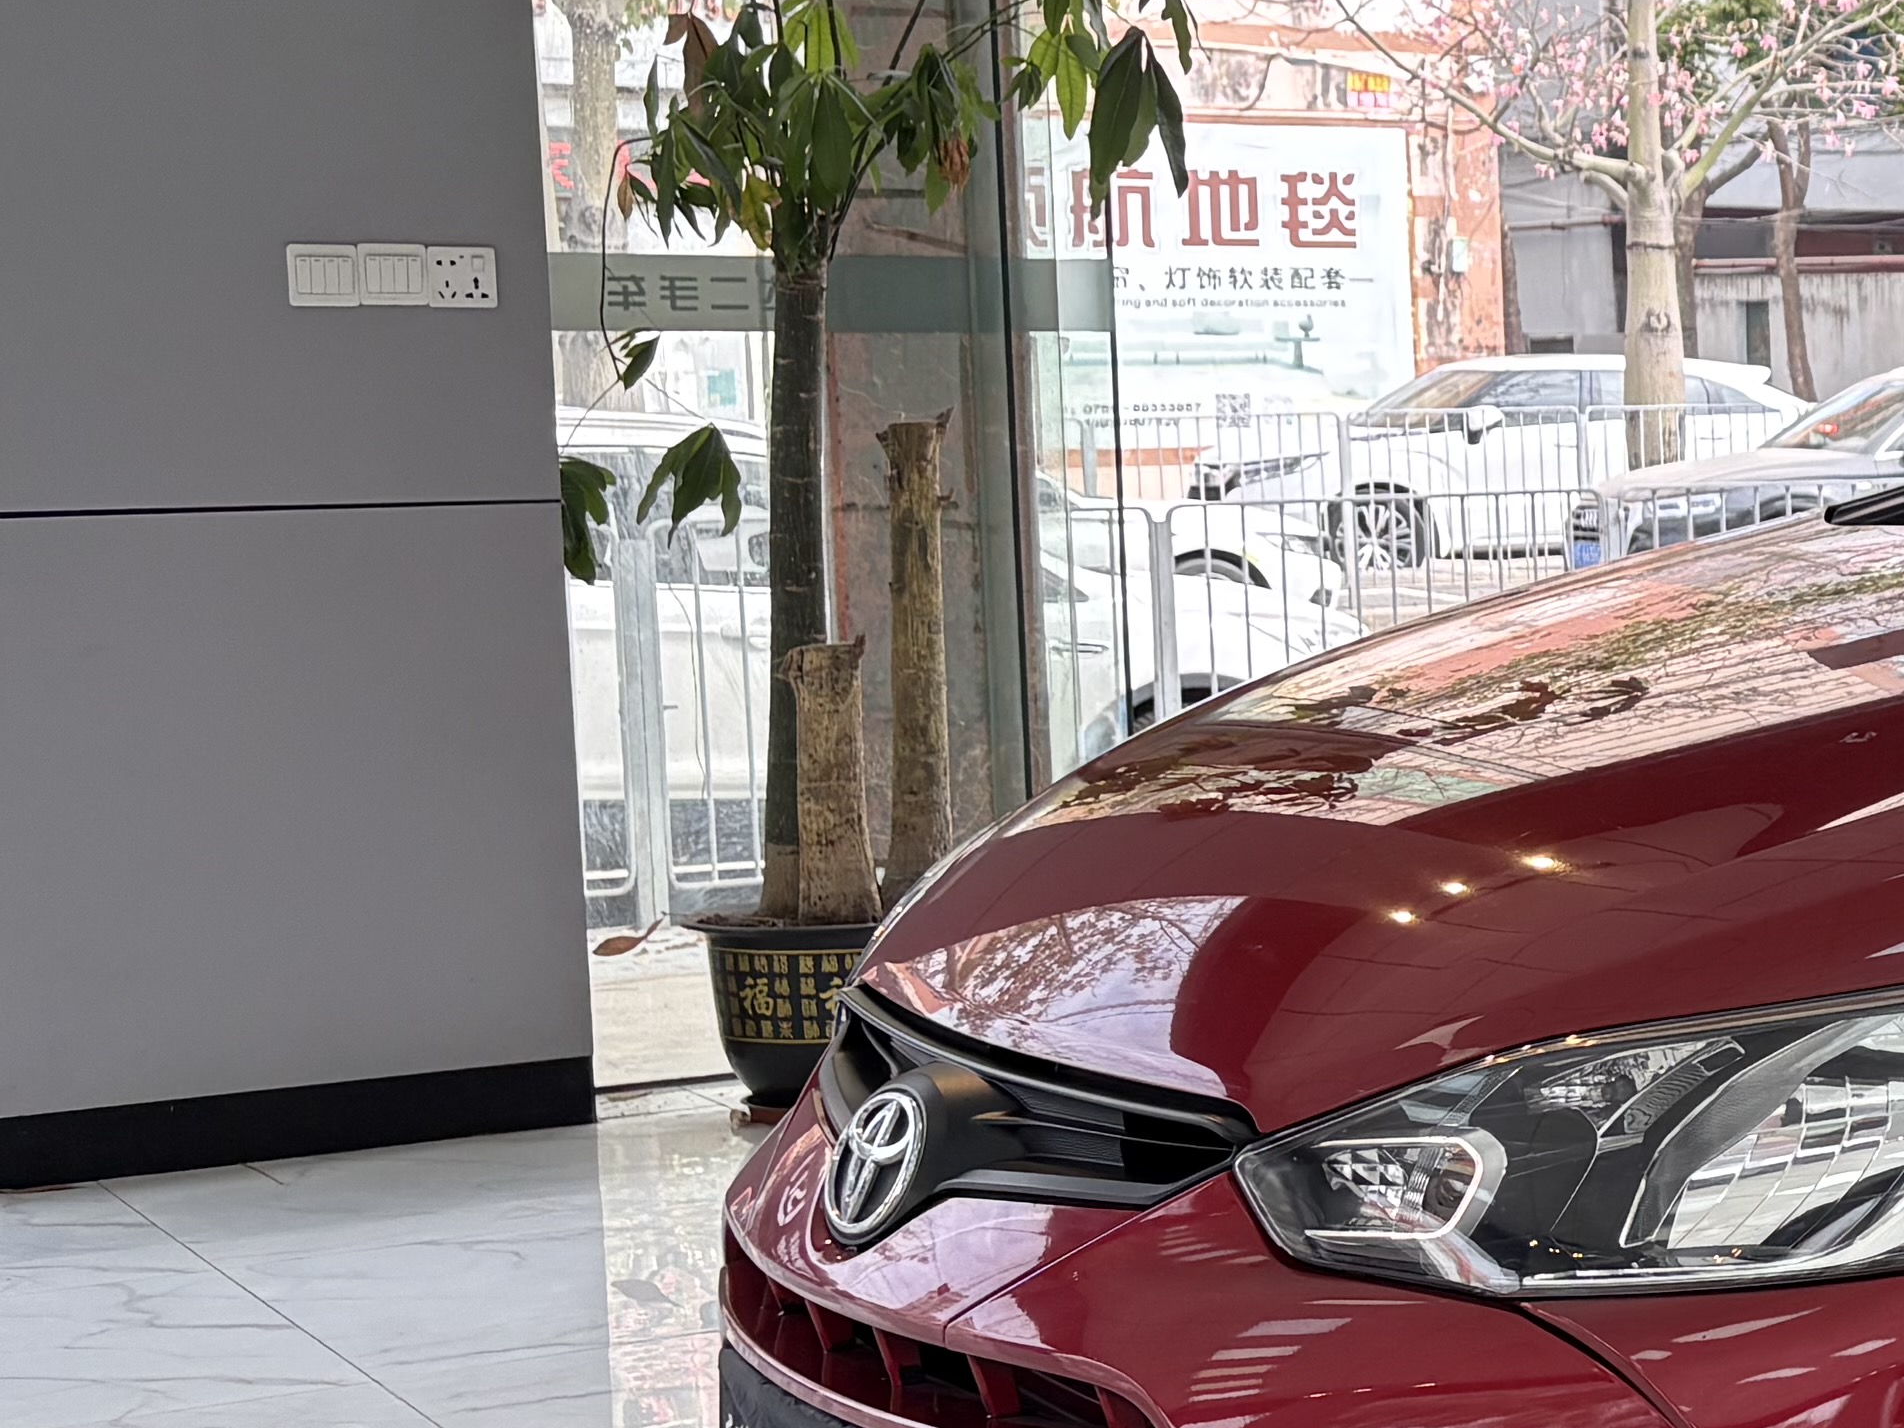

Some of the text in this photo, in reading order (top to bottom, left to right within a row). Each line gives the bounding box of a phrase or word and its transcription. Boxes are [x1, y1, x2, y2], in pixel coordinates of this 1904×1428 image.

[1025, 167, 1358, 250] 航地毯
[739, 976, 775, 1017] 福
